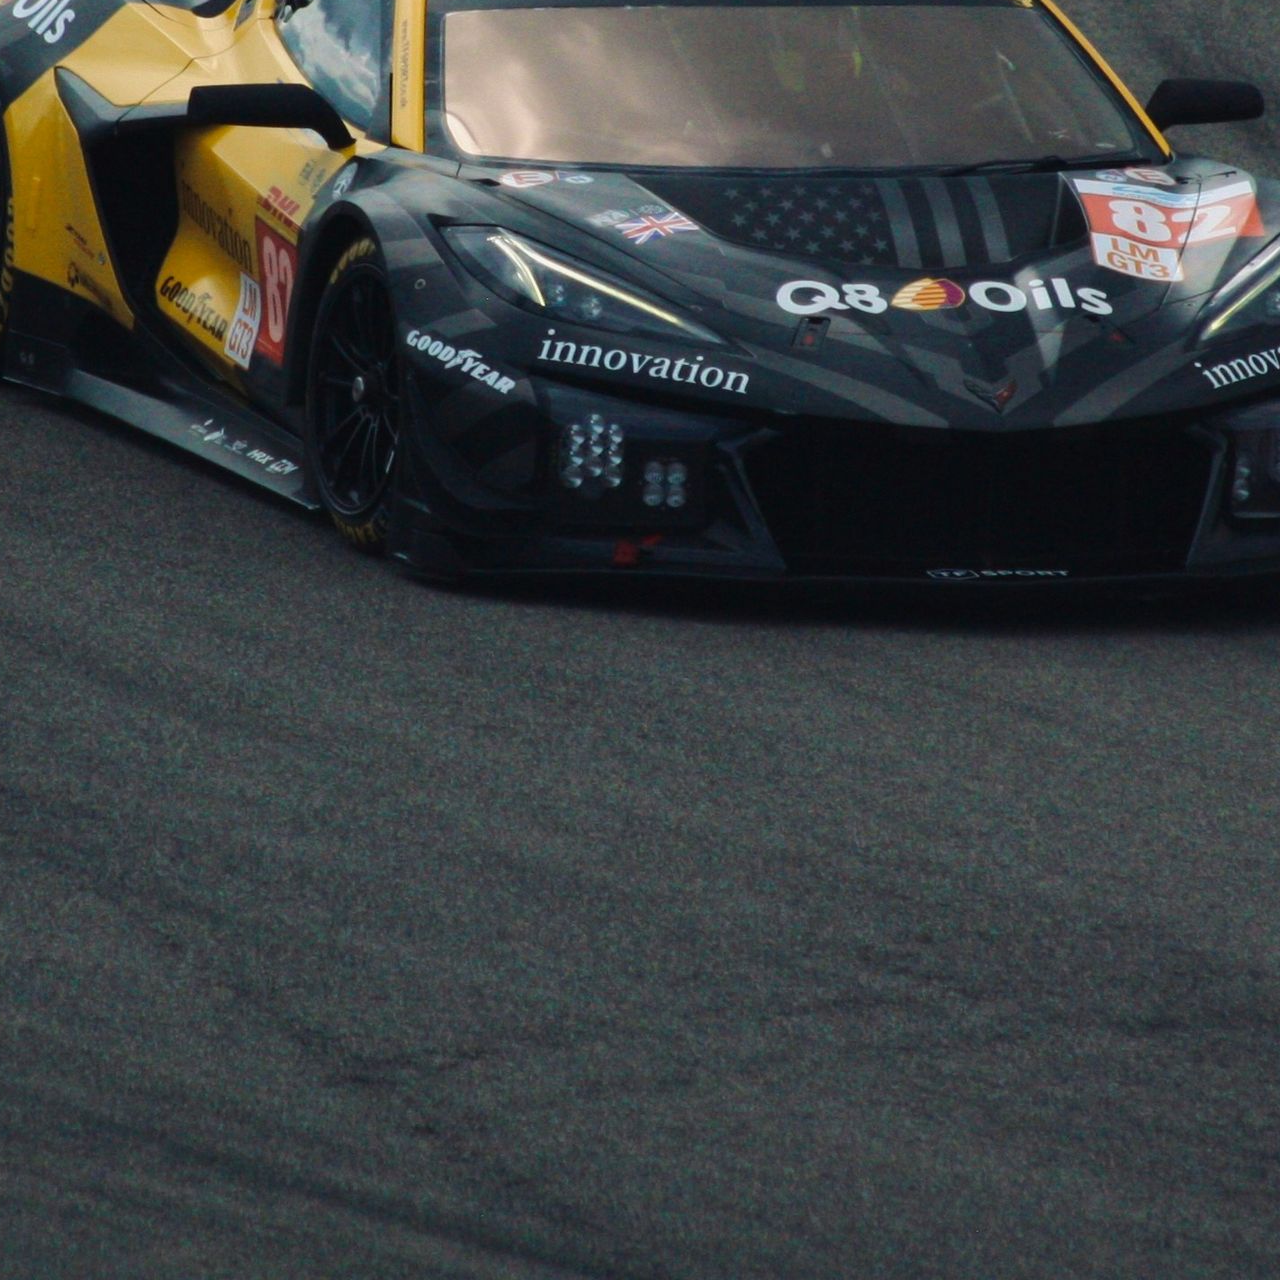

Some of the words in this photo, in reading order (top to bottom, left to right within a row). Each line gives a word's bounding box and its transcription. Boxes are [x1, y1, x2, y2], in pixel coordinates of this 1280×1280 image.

[1108, 199, 1237, 244] 82
[1106, 251, 1170, 279] GT3
[1110, 237, 1161, 263] LM
[160, 276, 228, 343] GOODYEAR
[262, 235, 295, 344] 82
[776, 280, 888, 315] Q8
[969, 277, 1113, 315] Oils
[228, 319, 255, 360] GT3
[537, 328, 750, 395] innovation
[406, 330, 516, 395] GOODYEAR
